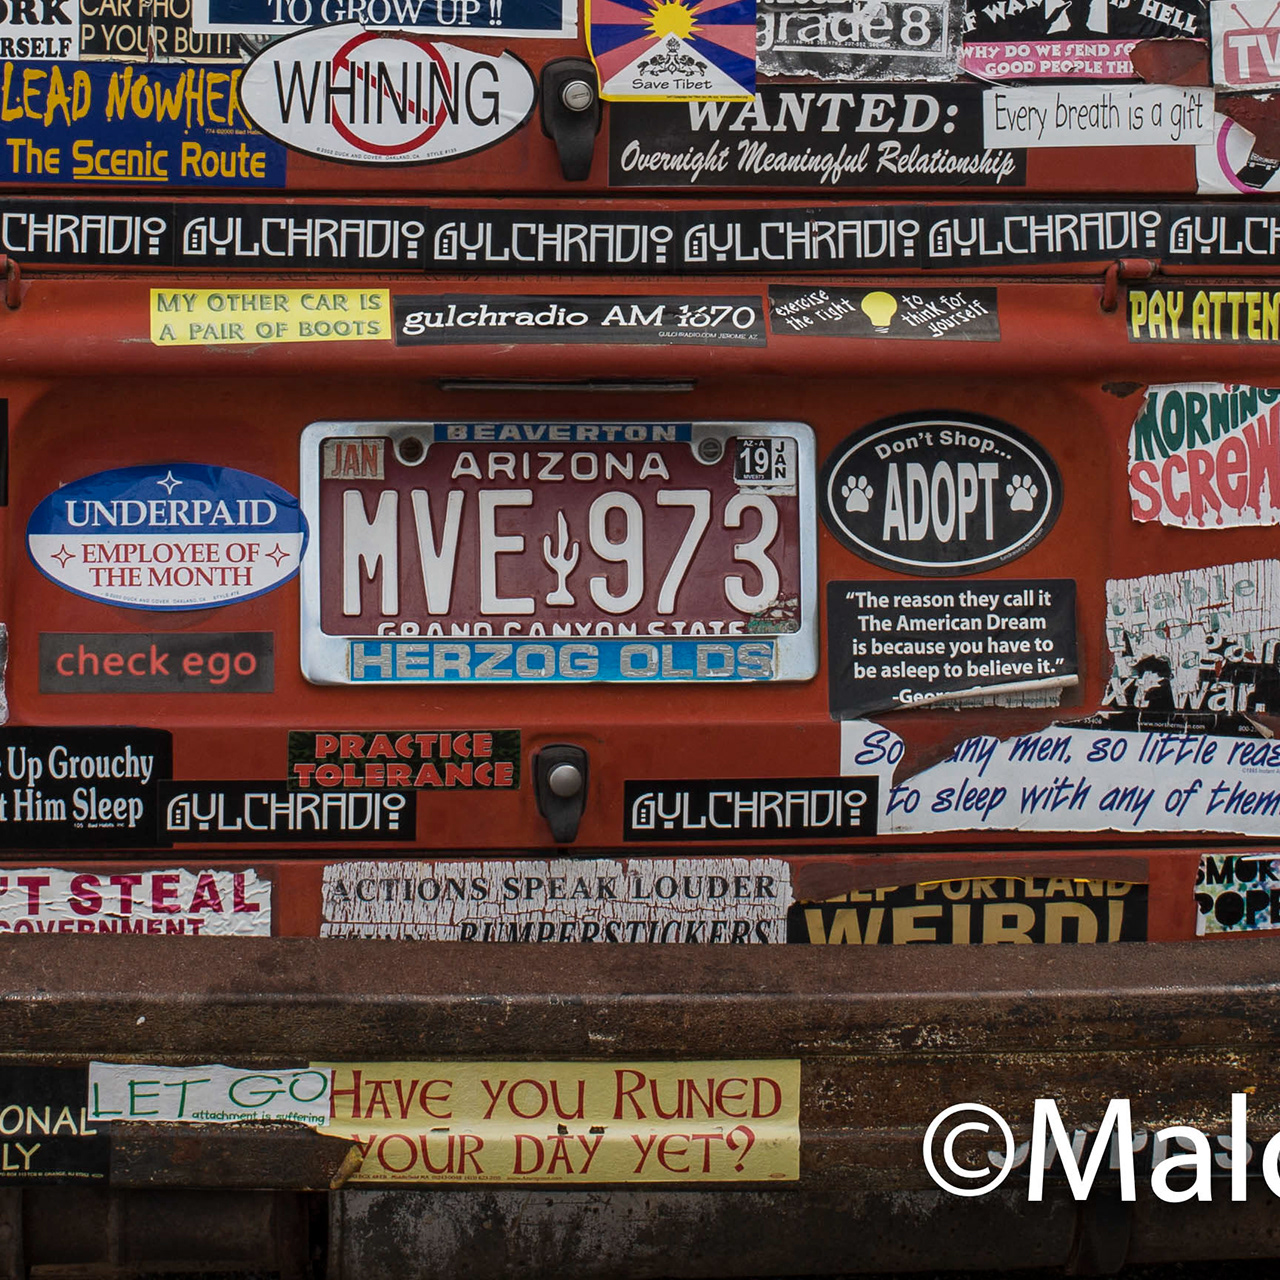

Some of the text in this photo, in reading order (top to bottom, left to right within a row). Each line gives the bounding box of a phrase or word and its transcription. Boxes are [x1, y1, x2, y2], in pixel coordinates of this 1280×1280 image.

[402, 305, 756, 335] gulchradio AM 1670
[1130, 291, 1188, 342] PAY
[446, 425, 677, 440] BEAVERTON
[875, 430, 1012, 461] Don't Shop...
[451, 451, 670, 481] ARIZONA
[883, 461, 999, 542] ADOPT
[342, 489, 781, 616] MVE 973
[56, 645, 257, 684] check ego
[352, 643, 775, 680] HERZOG OLDS
[329, 1069, 783, 1120] HAVE YOU RUNED
[351, 1124, 757, 1176] YOUR DAY YET?
